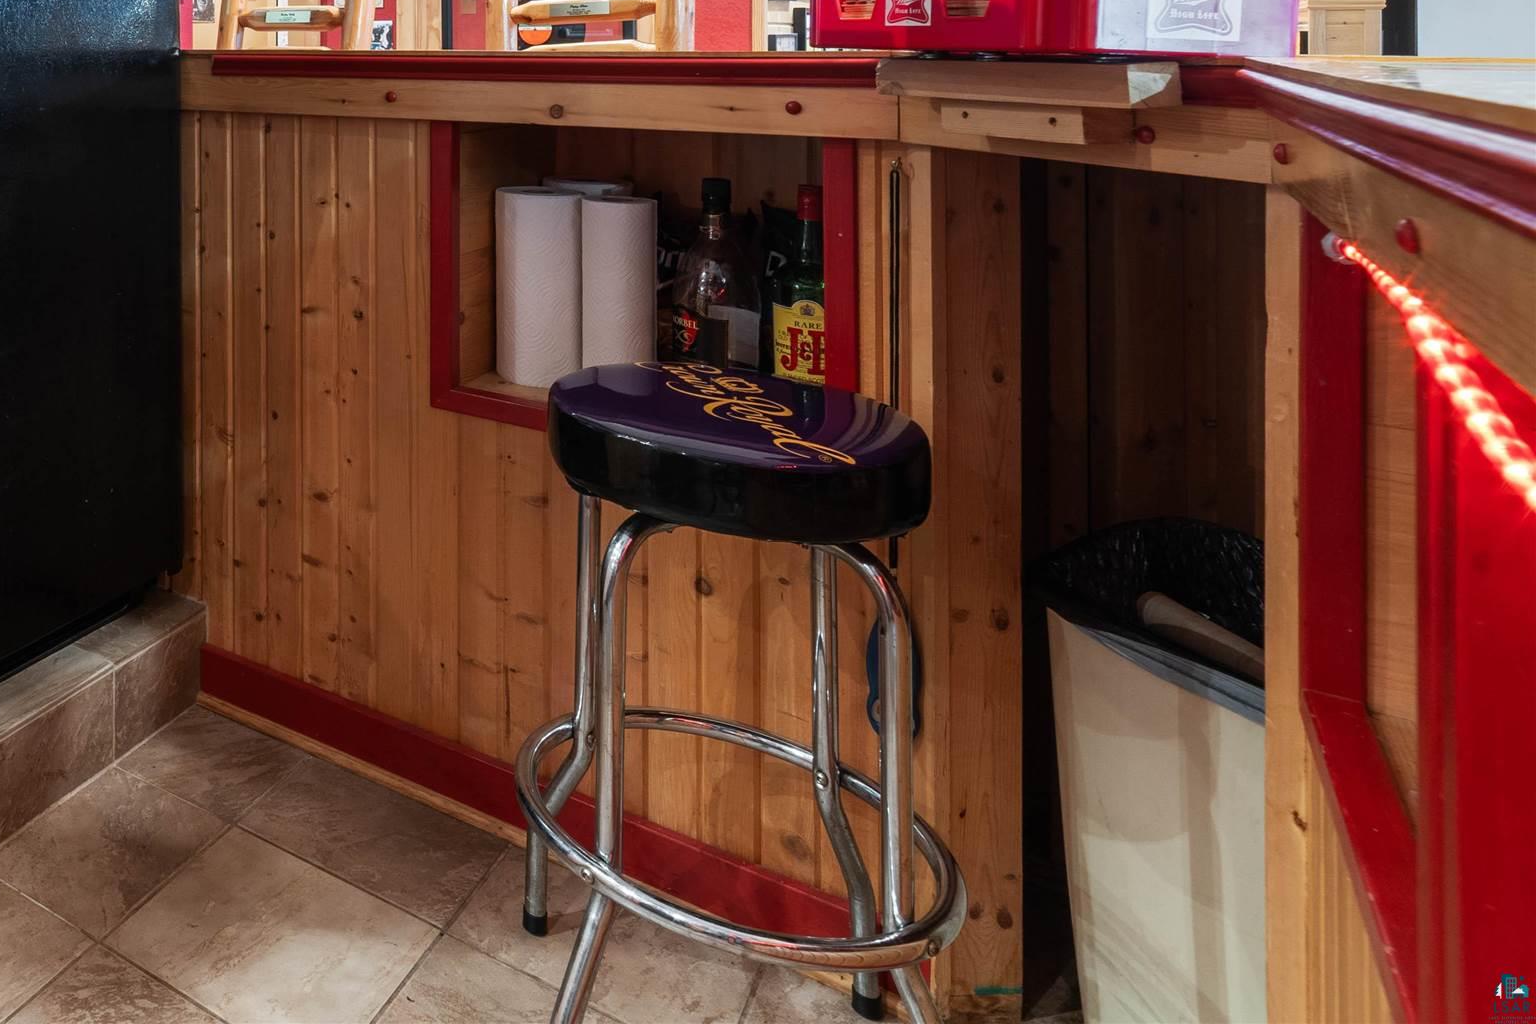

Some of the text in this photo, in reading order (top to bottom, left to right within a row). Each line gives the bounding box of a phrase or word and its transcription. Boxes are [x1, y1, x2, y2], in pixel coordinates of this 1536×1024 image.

[671, 315, 700, 331] ORBEL
[794, 320, 823, 330] RARE
[666, 380, 857, 465] Royal
